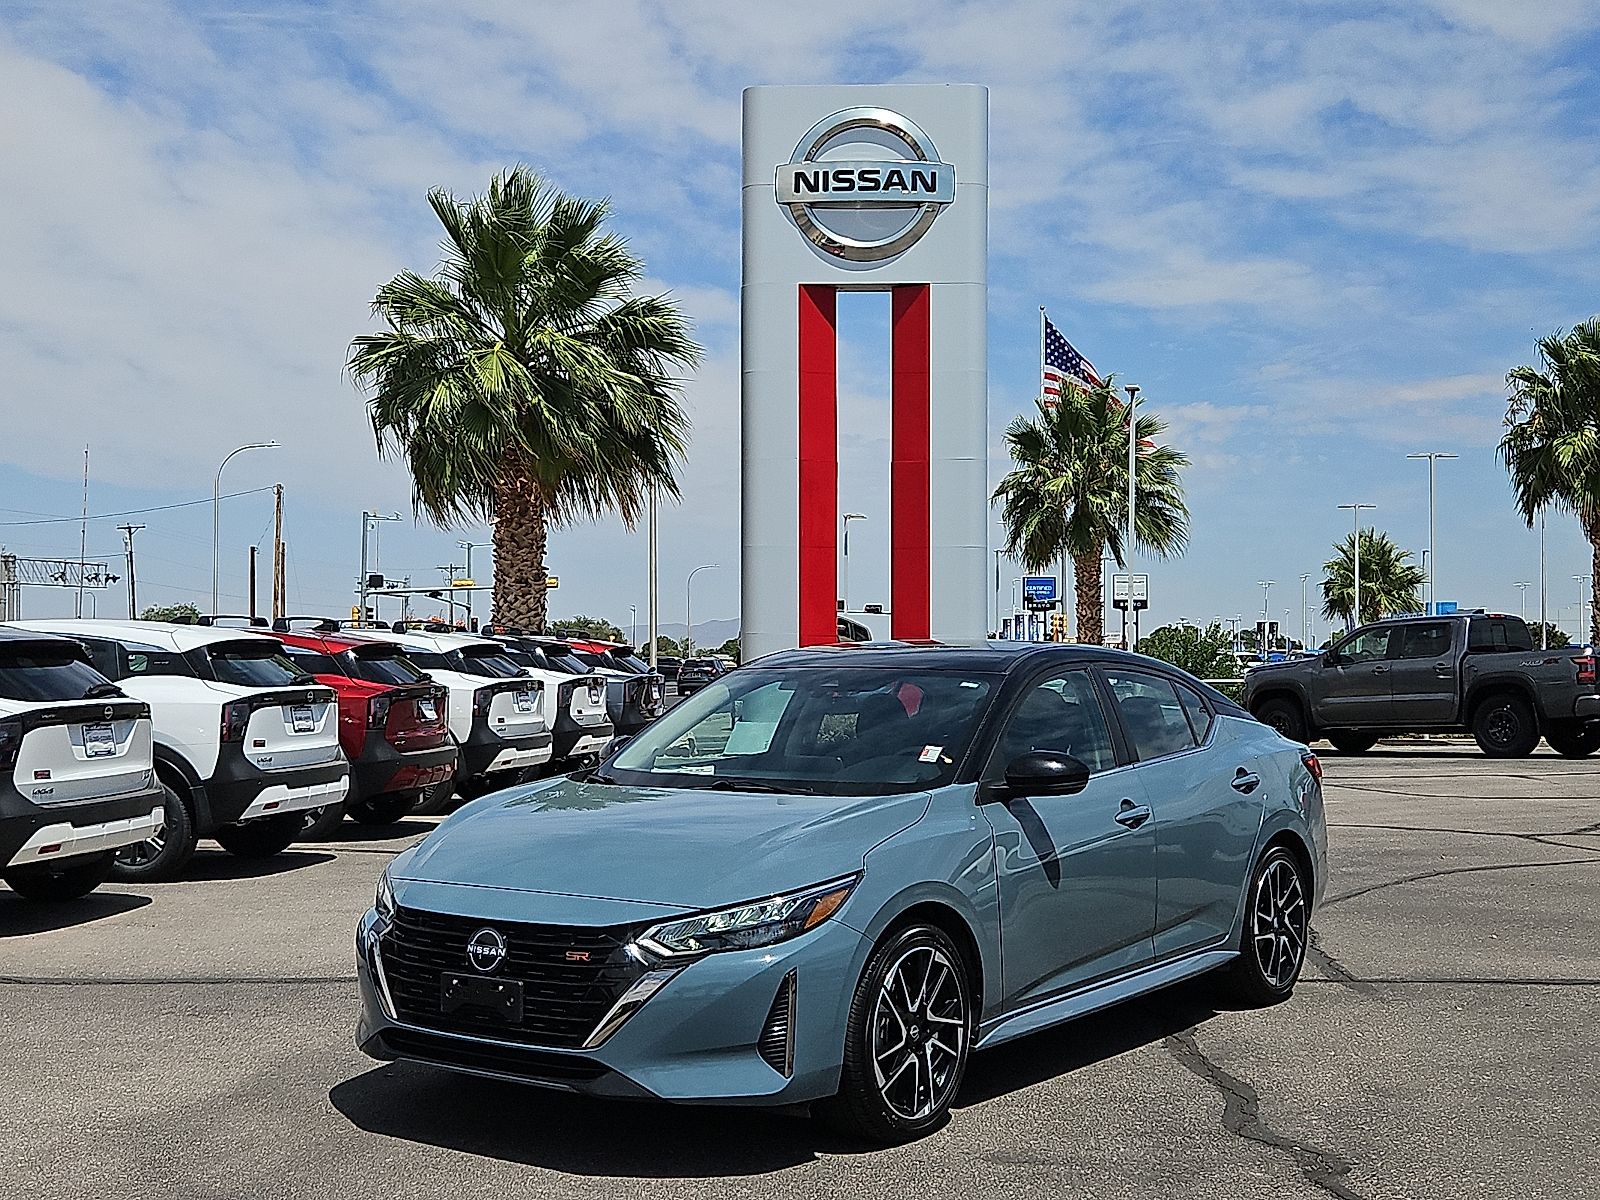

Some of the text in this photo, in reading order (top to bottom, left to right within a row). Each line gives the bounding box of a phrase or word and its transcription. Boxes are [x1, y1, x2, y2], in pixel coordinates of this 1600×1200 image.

[794, 169, 937, 194] NISSAN
[467, 944, 506, 957] NISSAN
[565, 951, 591, 961] SR
